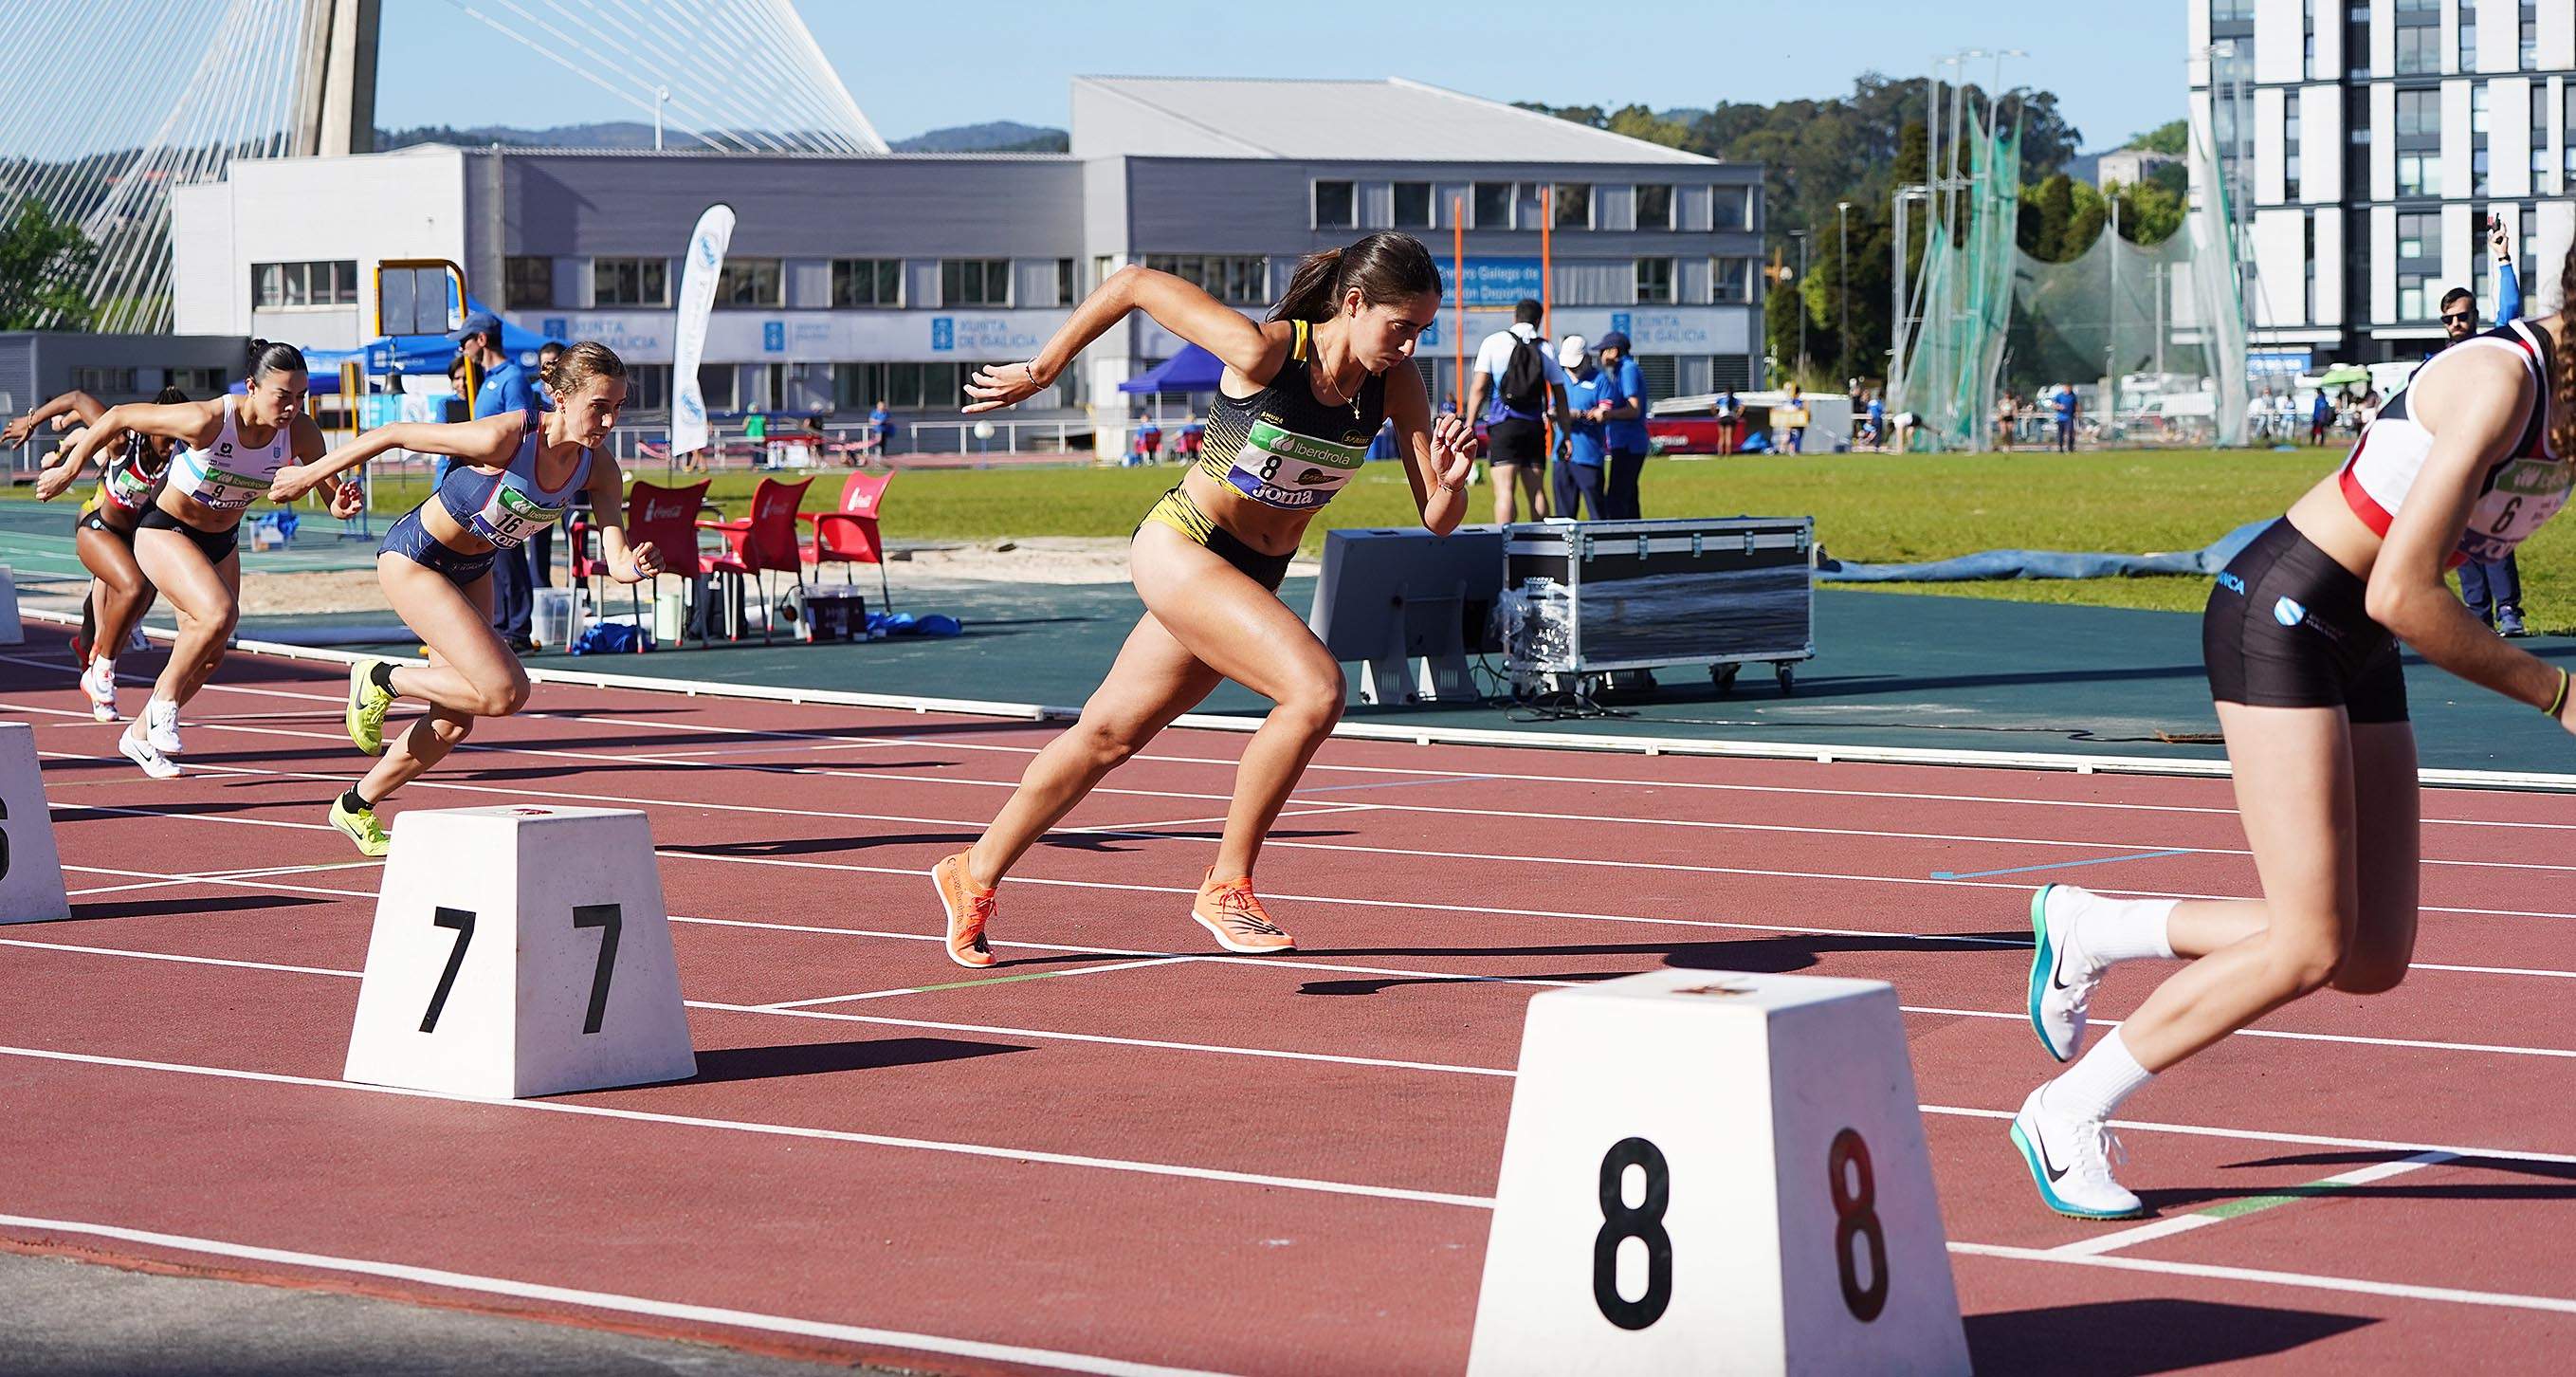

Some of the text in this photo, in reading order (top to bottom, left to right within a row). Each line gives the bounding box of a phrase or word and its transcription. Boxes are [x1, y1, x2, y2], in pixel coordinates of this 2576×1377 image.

[1259, 454, 1283, 482] 8
[1294, 442, 1351, 465] Iberdrola
[212, 485, 226, 498] 9
[1251, 484, 1314, 505] Joma
[495, 513, 524, 534] 16
[2490, 496, 2522, 535] 6
[419, 907, 477, 1034] 7
[573, 903, 622, 1035] 7
[1593, 1136, 1672, 1331] 8
[1828, 1127, 1890, 1324] 8
